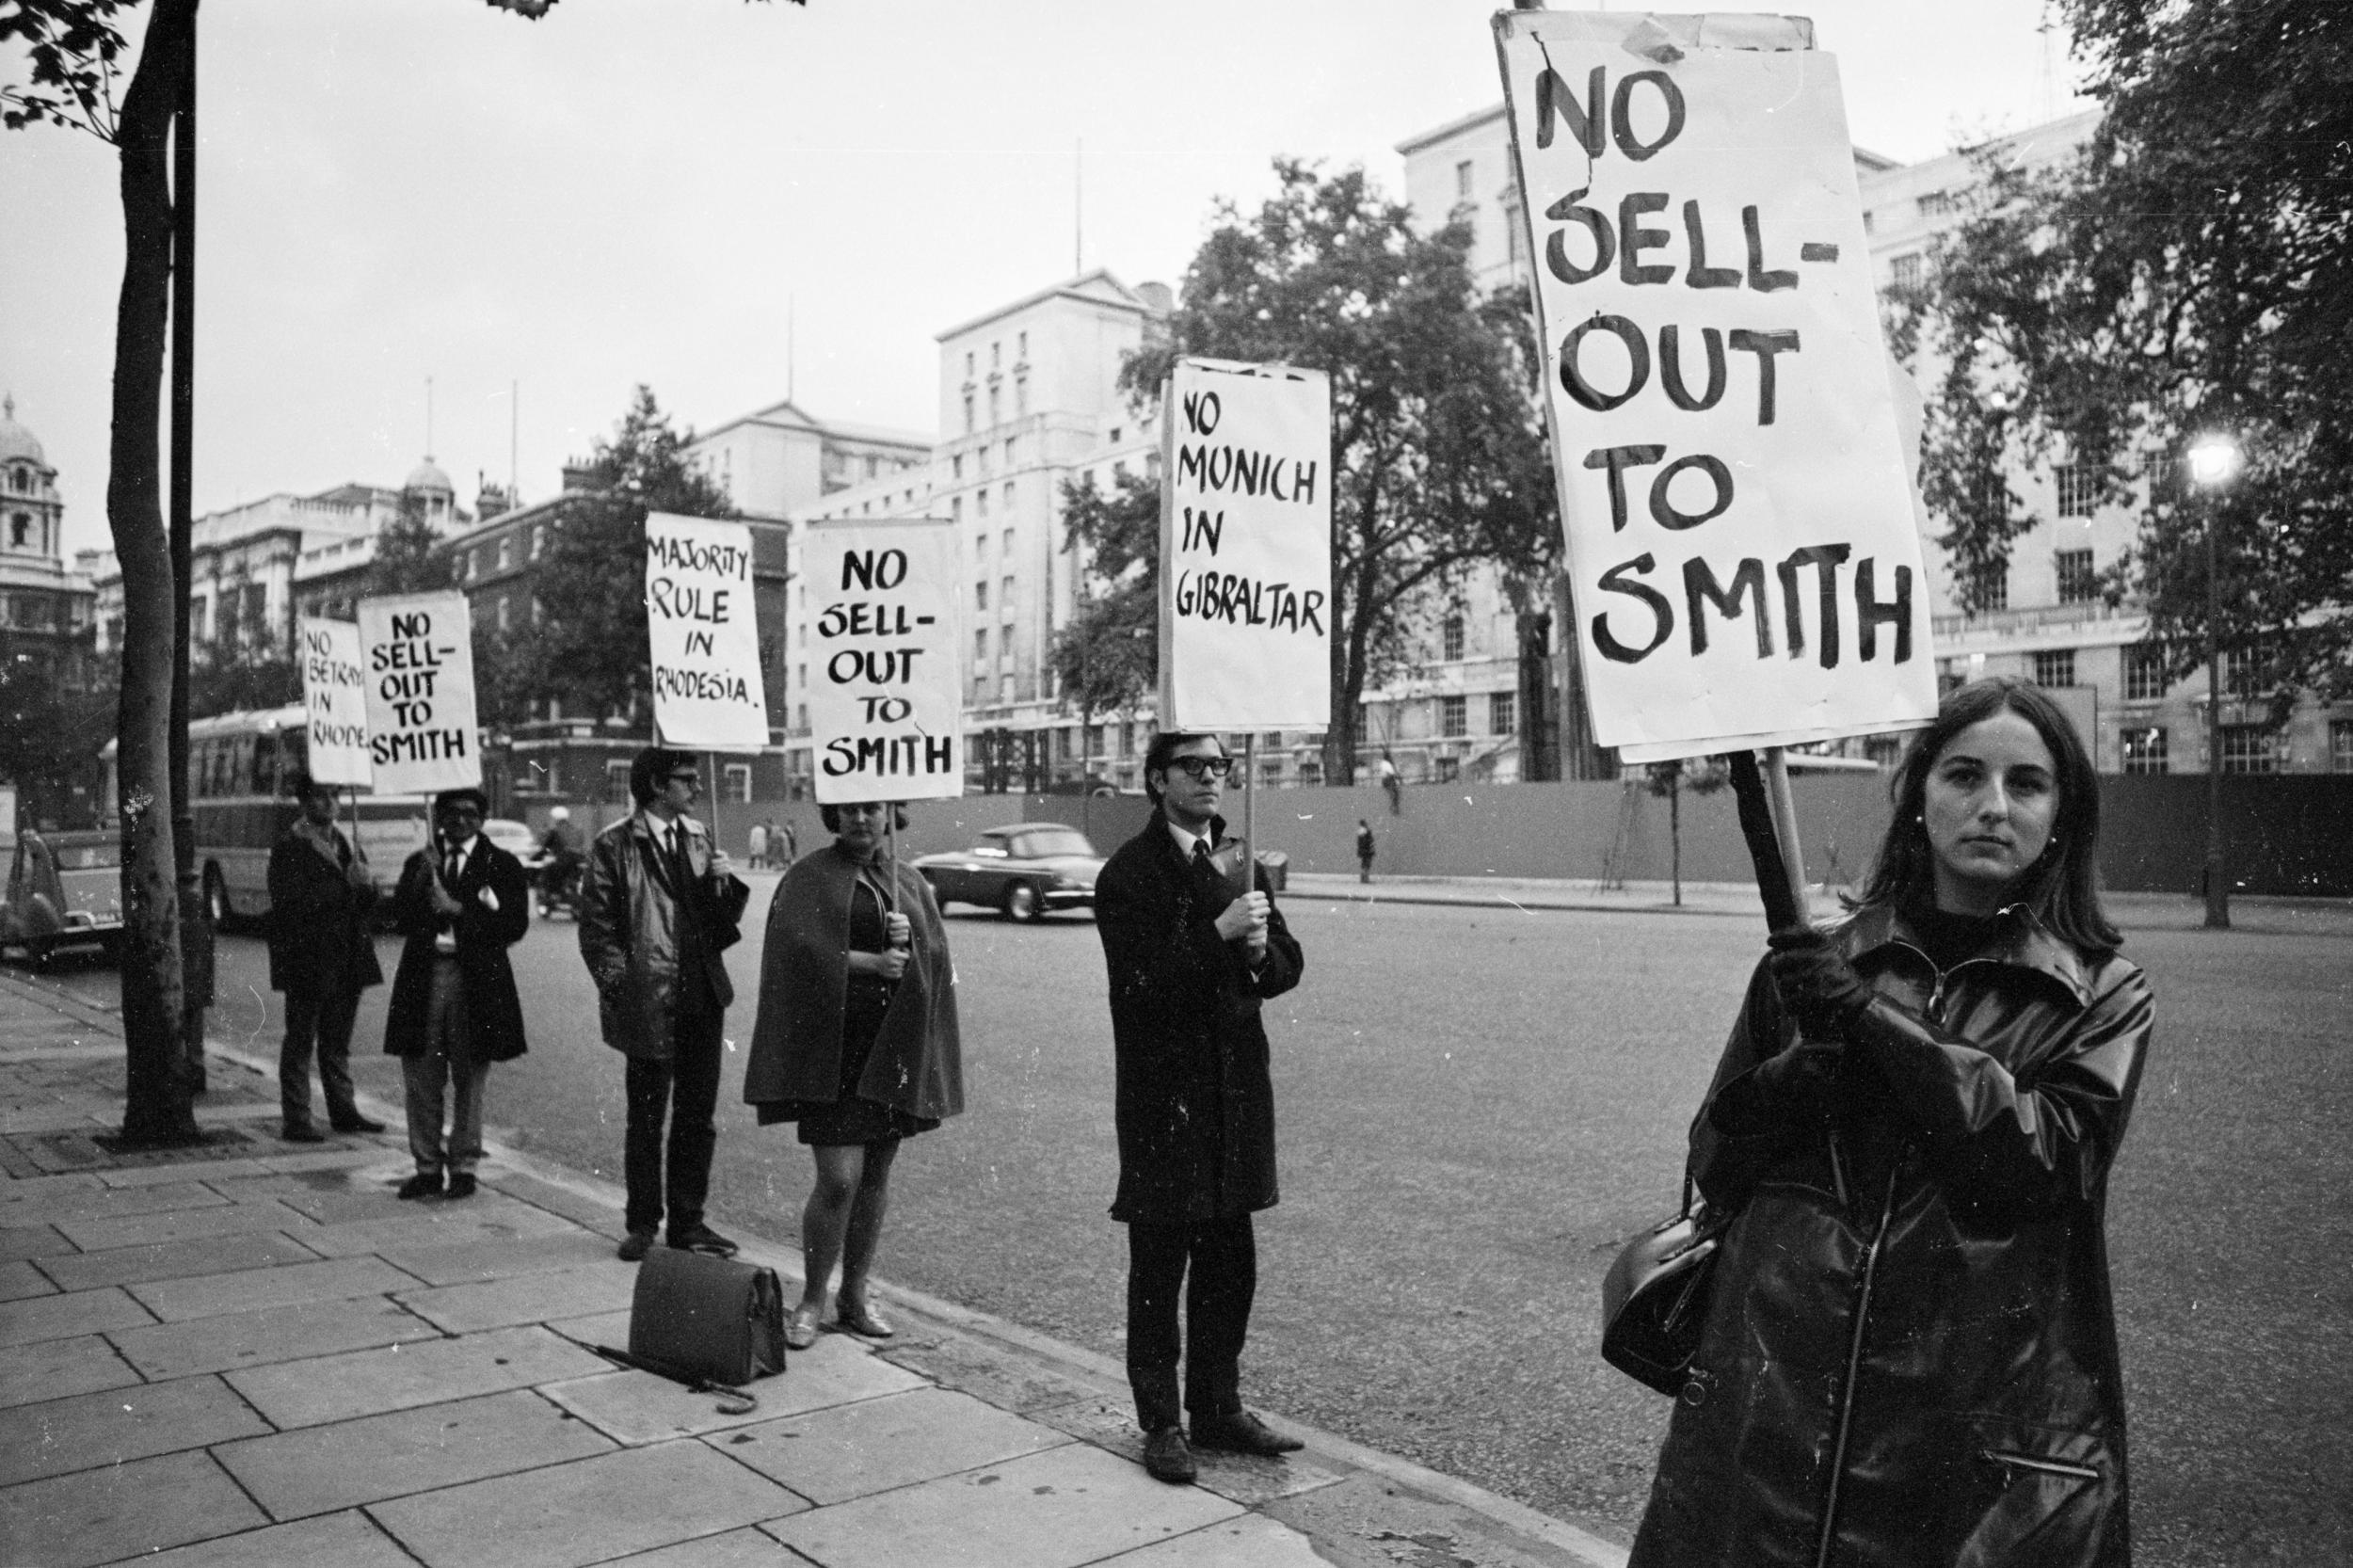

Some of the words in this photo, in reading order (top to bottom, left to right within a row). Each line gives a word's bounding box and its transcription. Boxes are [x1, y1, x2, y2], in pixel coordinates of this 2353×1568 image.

[1535, 65, 1686, 162] NO
[1545, 186, 1839, 292] SELL-
[1559, 314, 1801, 426] OUT
[1182, 391, 1221, 436] NO
[1177, 443, 1317, 504] MUNICH
[1582, 444, 1734, 534] TO
[1182, 507, 1224, 556] IN
[648, 536, 748, 581] MAJORITY
[841, 549, 907, 590] NO
[651, 577, 729, 623] RULE
[818, 602, 936, 638] SELL-
[1176, 569, 1324, 636] GIBRALTAR
[1591, 543, 1913, 669] SMITH
[307, 632, 331, 657] NO
[392, 613, 431, 640] NO
[685, 632, 713, 657] IN
[372, 641, 456, 671] SELL-
[828, 648, 923, 684] OUT
[312, 692, 331, 712] IN
[380, 670, 439, 701] OUT
[656, 664, 760, 708] RHODESIA.
[392, 700, 433, 728] TO
[857, 696, 912, 724] TO
[313, 720, 370, 748] RHODE
[372, 729, 465, 764] SMITH
[823, 735, 952, 776] SMITH
